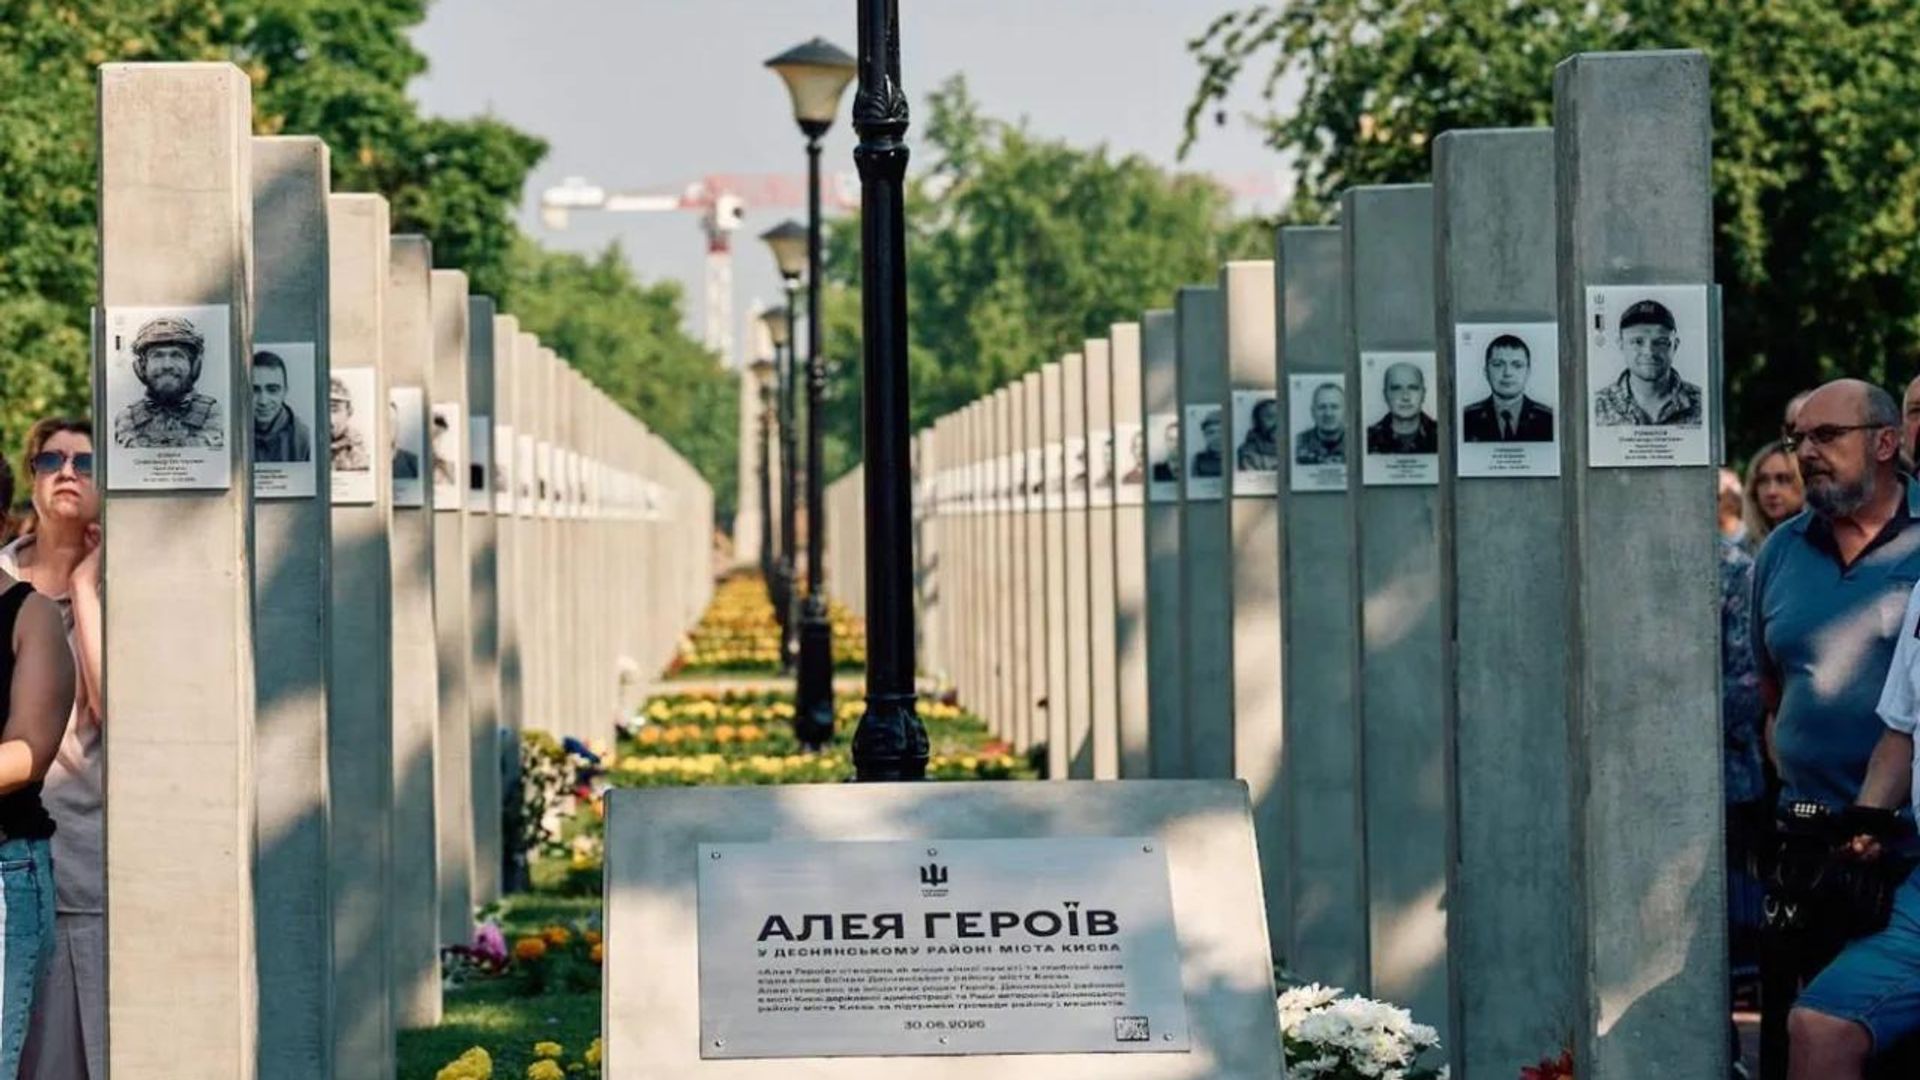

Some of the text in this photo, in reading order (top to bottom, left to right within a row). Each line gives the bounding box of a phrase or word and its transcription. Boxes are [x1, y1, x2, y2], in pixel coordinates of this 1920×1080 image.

[757, 901, 1119, 941] АЛЕЯ ГЕРОЇВ
[757, 943, 1121, 958] У ДЕСНЯНСЬКОМУ РАЙОНІ МІСТА КИЄВА
